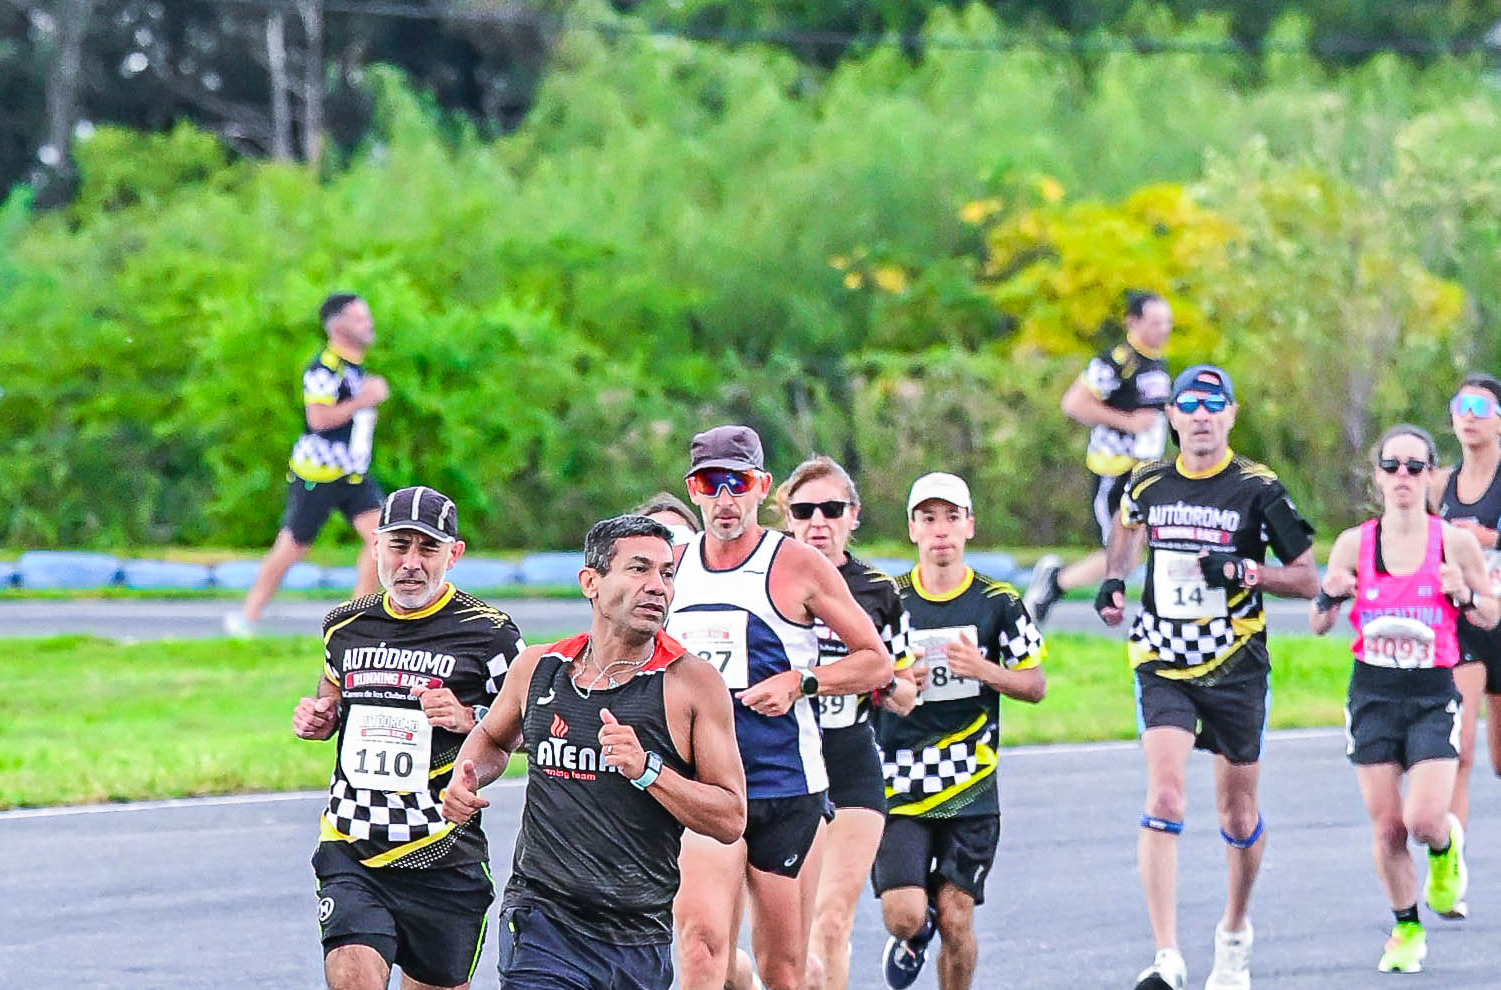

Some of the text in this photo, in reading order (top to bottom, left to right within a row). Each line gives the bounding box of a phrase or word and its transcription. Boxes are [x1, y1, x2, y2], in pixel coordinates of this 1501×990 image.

[1148, 500, 1240, 532] AUTÓDROMO
[1173, 587, 1204, 606] 14
[342, 642, 456, 678] AUTÓDROMO
[353, 672, 431, 689] RUNNING RACE
[354, 749, 414, 778] 110
[571, 770, 596, 780] team
